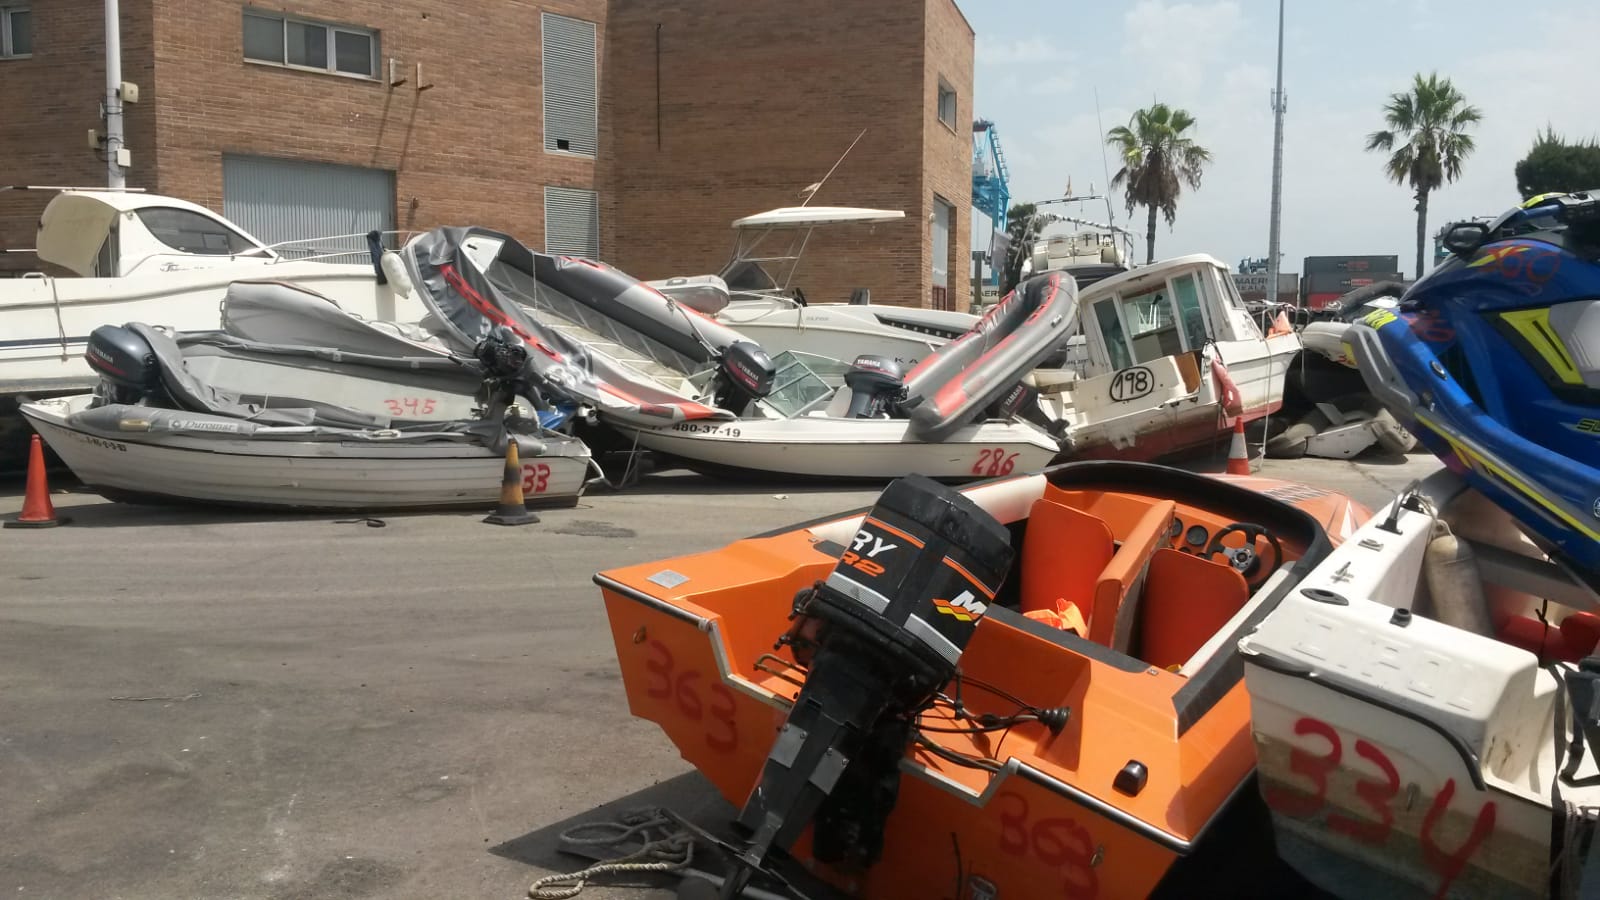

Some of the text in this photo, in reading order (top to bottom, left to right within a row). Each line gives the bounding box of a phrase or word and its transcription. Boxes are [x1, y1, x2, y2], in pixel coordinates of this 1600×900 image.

[857, 359, 881, 368] YAMAHA
[1004, 384, 1024, 407] YAMAHA
[1115, 371, 1148, 399] 198
[384, 397, 437, 417] 345
[672, 423, 741, 438] 480-37-19
[972, 447, 1021, 477] 286
[646, 639, 739, 755] 363
[1266, 717, 1497, 900] 334
